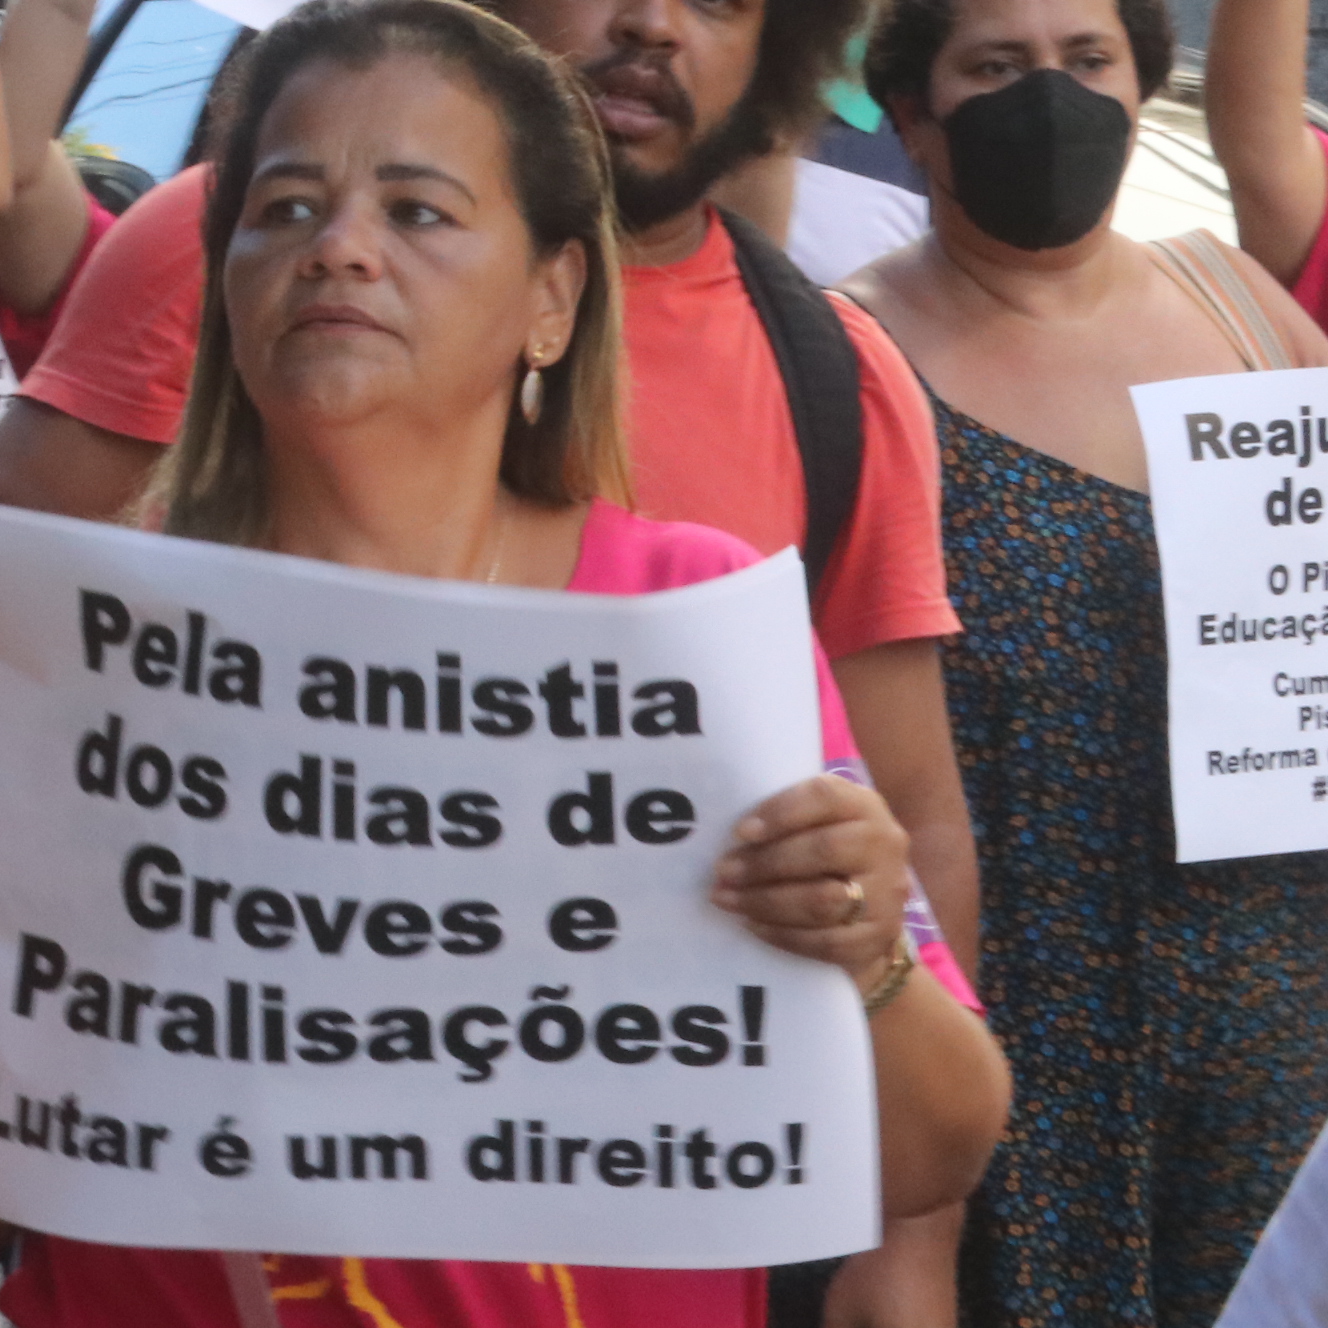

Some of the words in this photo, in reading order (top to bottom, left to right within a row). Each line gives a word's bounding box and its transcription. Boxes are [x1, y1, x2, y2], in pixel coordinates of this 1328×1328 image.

[1265, 476, 1323, 527] de
[1268, 564, 1289, 595] O
[77, 588, 263, 709] Pela
[297, 651, 704, 740] anistia
[75, 714, 230, 823] dos
[263, 752, 504, 849] dias
[546, 773, 696, 848] de
[1206, 746, 1318, 776] Reforma
[120, 844, 505, 958] Greves
[548, 893, 621, 955] e
[12, 930, 770, 1084] Paralisações!
[199, 1117, 253, 1178] é
[288, 1132, 430, 1182] um
[463, 1120, 807, 1191] direito!
